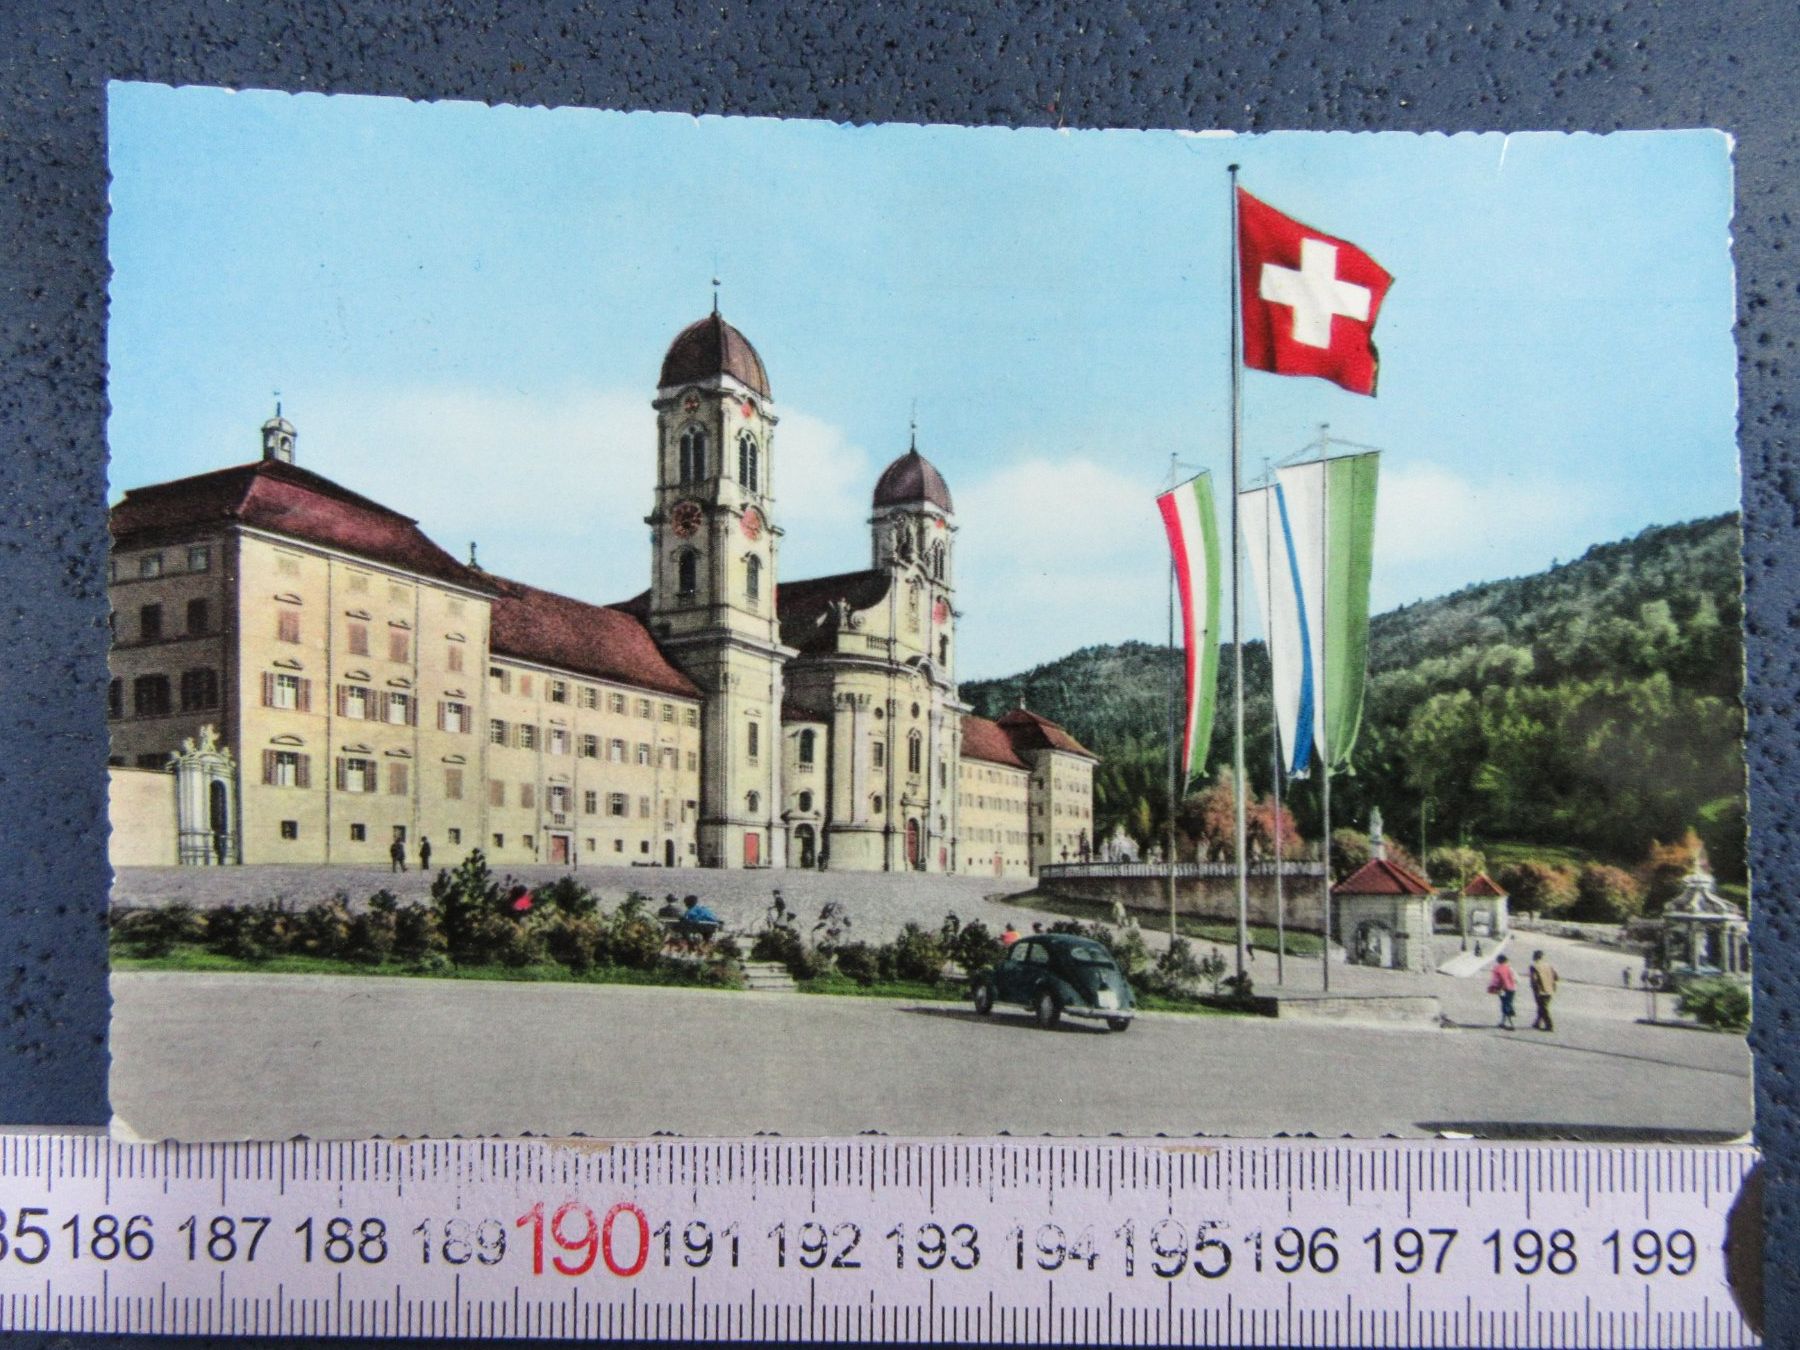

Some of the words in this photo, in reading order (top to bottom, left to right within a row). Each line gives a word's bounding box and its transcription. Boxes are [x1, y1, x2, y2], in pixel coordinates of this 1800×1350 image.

[0, 1207, 50, 1264] 5
[62, 1214, 154, 1261] 186
[178, 1215, 272, 1262] 187
[294, 1216, 388, 1264] 188
[412, 1217, 507, 1265] 189
[515, 1200, 650, 1277] 190
[653, 1220, 740, 1268] 191
[767, 1221, 862, 1269] 192
[885, 1222, 981, 1270] 193
[1005, 1223, 1100, 1271] 194
[1114, 1217, 1233, 1279] 195
[1243, 1227, 1339, 1274] 196
[1362, 1227, 1459, 1274] 197
[1482, 1228, 1578, 1275] 198
[1601, 1228, 1698, 1275] 199
